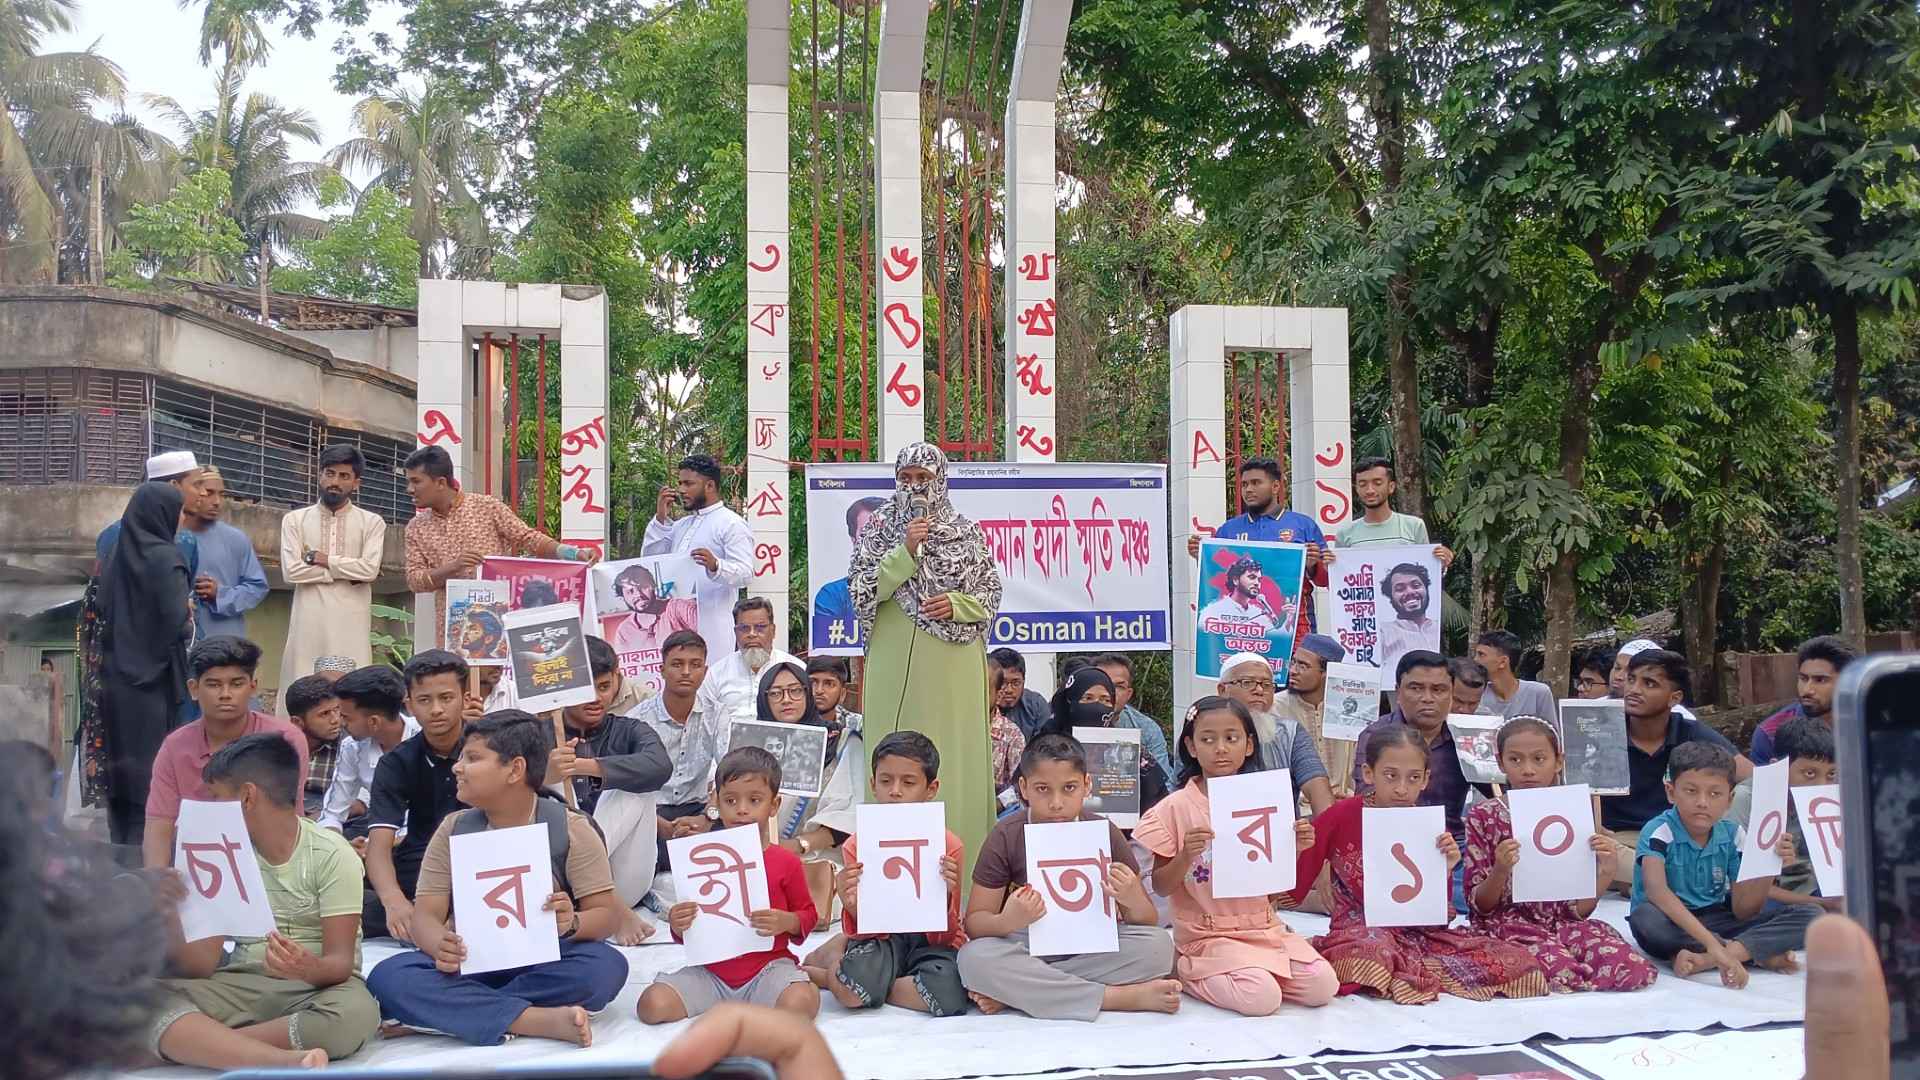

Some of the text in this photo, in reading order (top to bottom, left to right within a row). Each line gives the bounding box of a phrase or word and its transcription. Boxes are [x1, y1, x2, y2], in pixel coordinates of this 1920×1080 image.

[1192, 431, 1221, 469] A
[1031, 495, 1070, 582] হাদী
[1073, 496, 1114, 605] স্মৃতি
[1118, 517, 1151, 576] মঞ্চ
[1344, 564, 1374, 586] আমি
[468, 591, 495, 603] Hadi
[1337, 587, 1375, 600] আমার
[994, 617, 1086, 642] Osman
[1095, 614, 1152, 640] Hadi
[1231, 806, 1278, 863] র
[181, 832, 250, 904] চা
[475, 864, 531, 929] র
[687, 842, 757, 926] হী
[878, 839, 929, 899] ন
[1037, 848, 1112, 917] তা
[1391, 843, 1424, 904] ১
